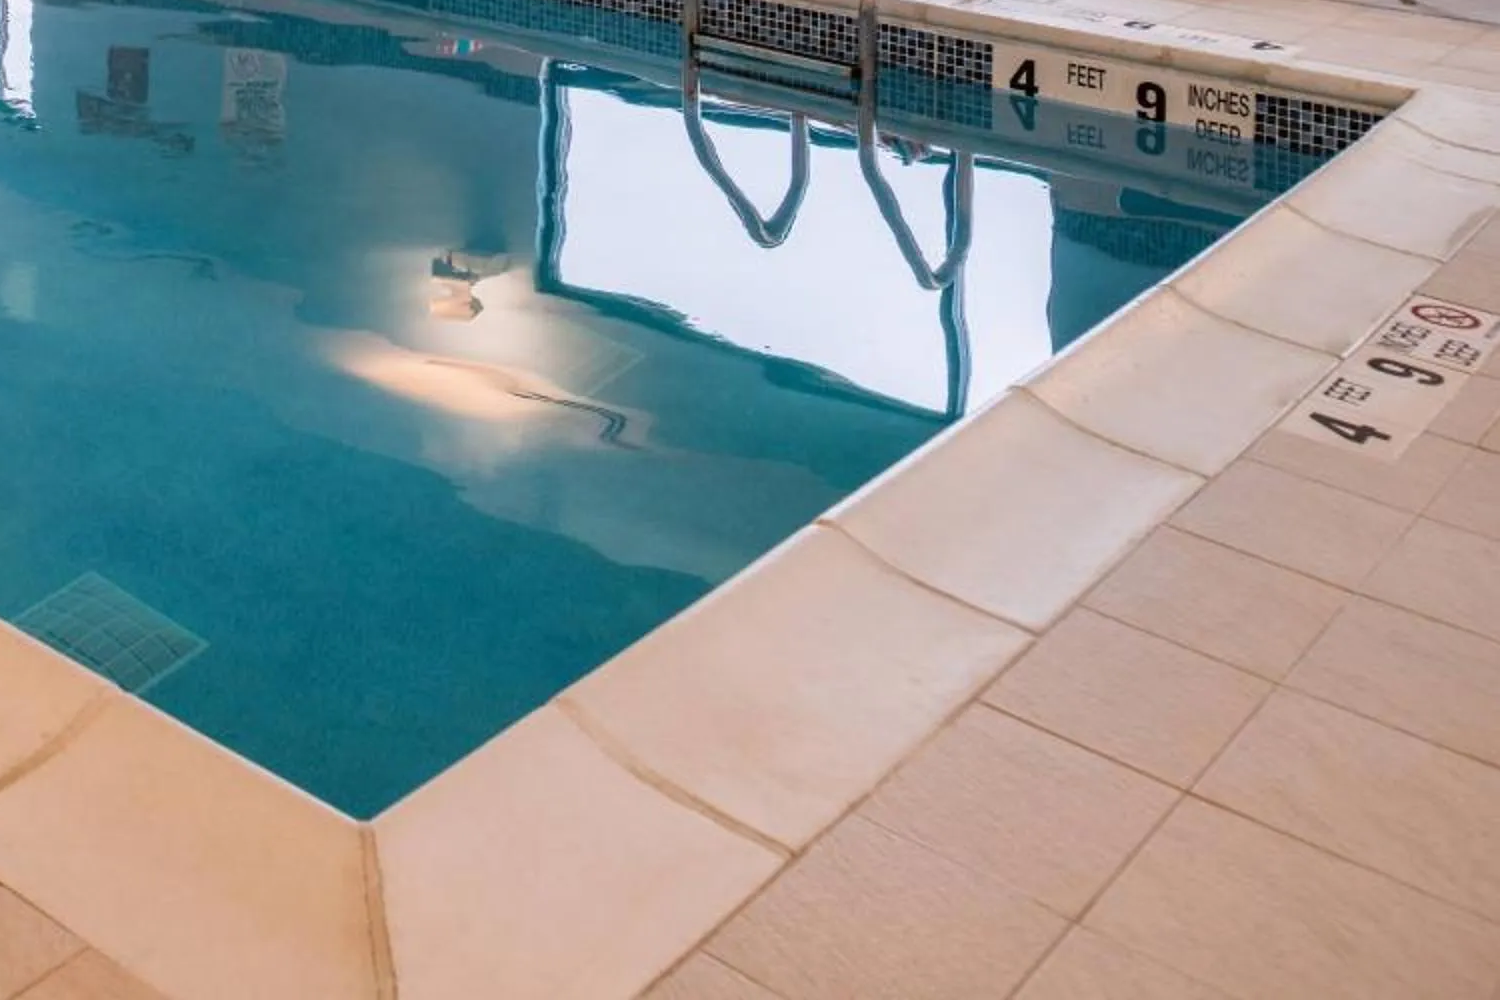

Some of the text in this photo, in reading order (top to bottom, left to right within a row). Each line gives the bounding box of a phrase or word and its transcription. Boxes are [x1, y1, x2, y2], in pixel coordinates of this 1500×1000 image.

[1009, 59, 1250, 124] 4 FEET 9 INCHES
[1367, 357, 1445, 386] 9
[1323, 377, 1374, 407] FEET
[1309, 411, 1392, 444] 4
